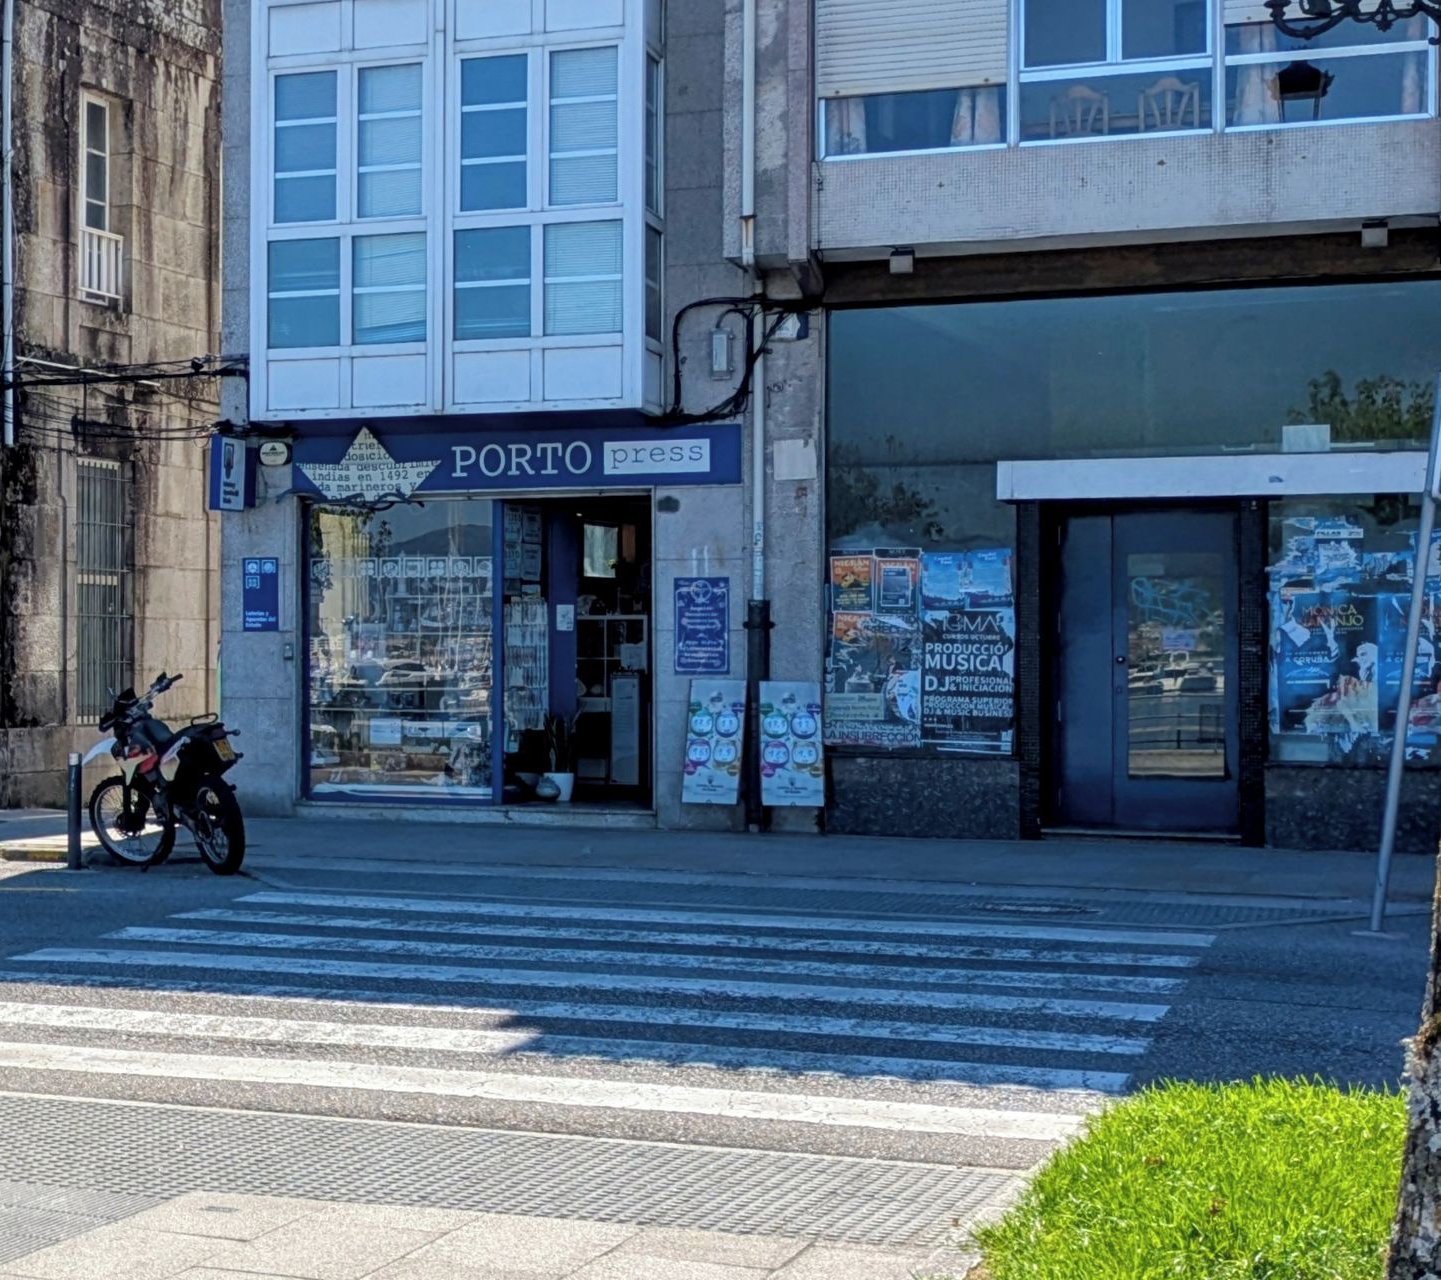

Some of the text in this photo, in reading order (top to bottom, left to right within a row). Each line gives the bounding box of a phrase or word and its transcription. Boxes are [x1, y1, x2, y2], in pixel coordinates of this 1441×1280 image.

[451, 441, 704, 477] PORTO press
[312, 471, 351, 481] indias
[358, 473, 372, 482] en
[380, 471, 408, 481] 1492
[336, 482, 402, 493] marineros
[925, 653, 1003, 671] MUSICA
[924, 675, 950, 692] DJ
[924, 695, 970, 703] PROGRAMA
[943, 709, 970, 717] MUSIC
